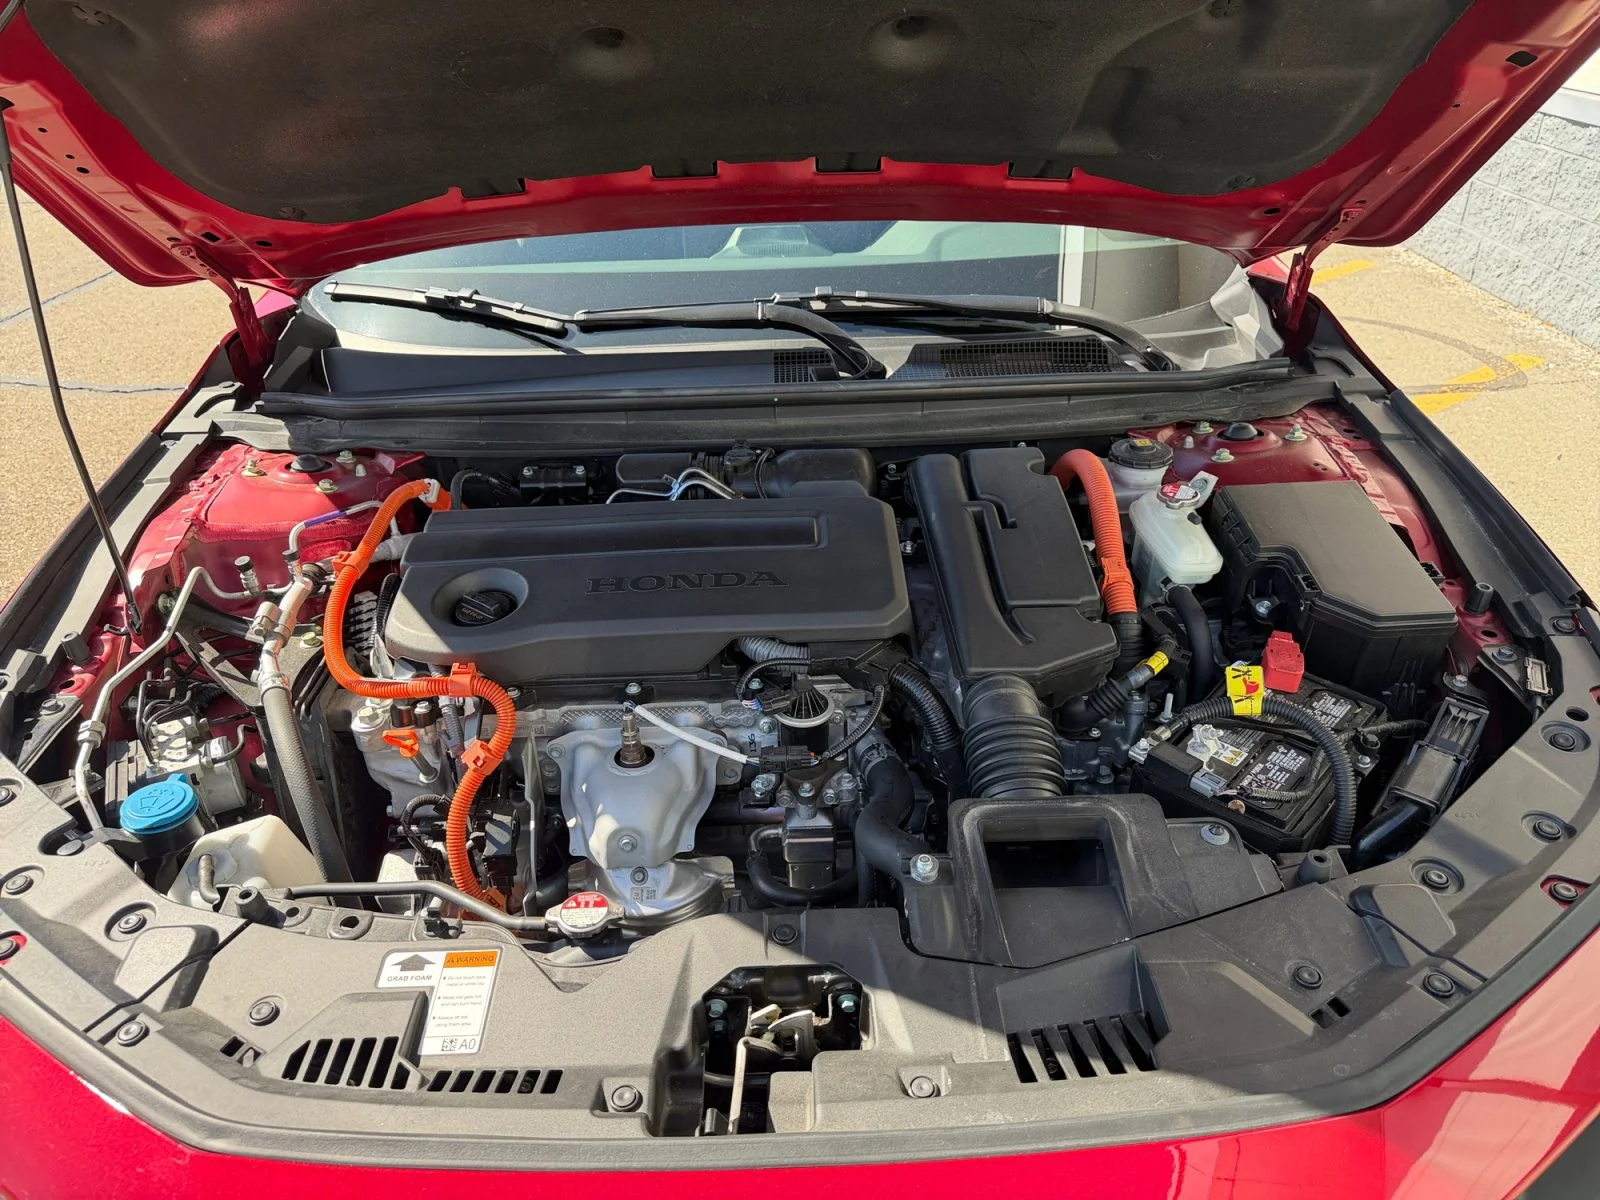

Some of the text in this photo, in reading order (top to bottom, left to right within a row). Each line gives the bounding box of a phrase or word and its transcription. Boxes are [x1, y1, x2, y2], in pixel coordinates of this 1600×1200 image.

[584, 571, 790, 594] HONDA
[456, 955, 495, 963] WARNING
[458, 1038, 476, 1050] A0
